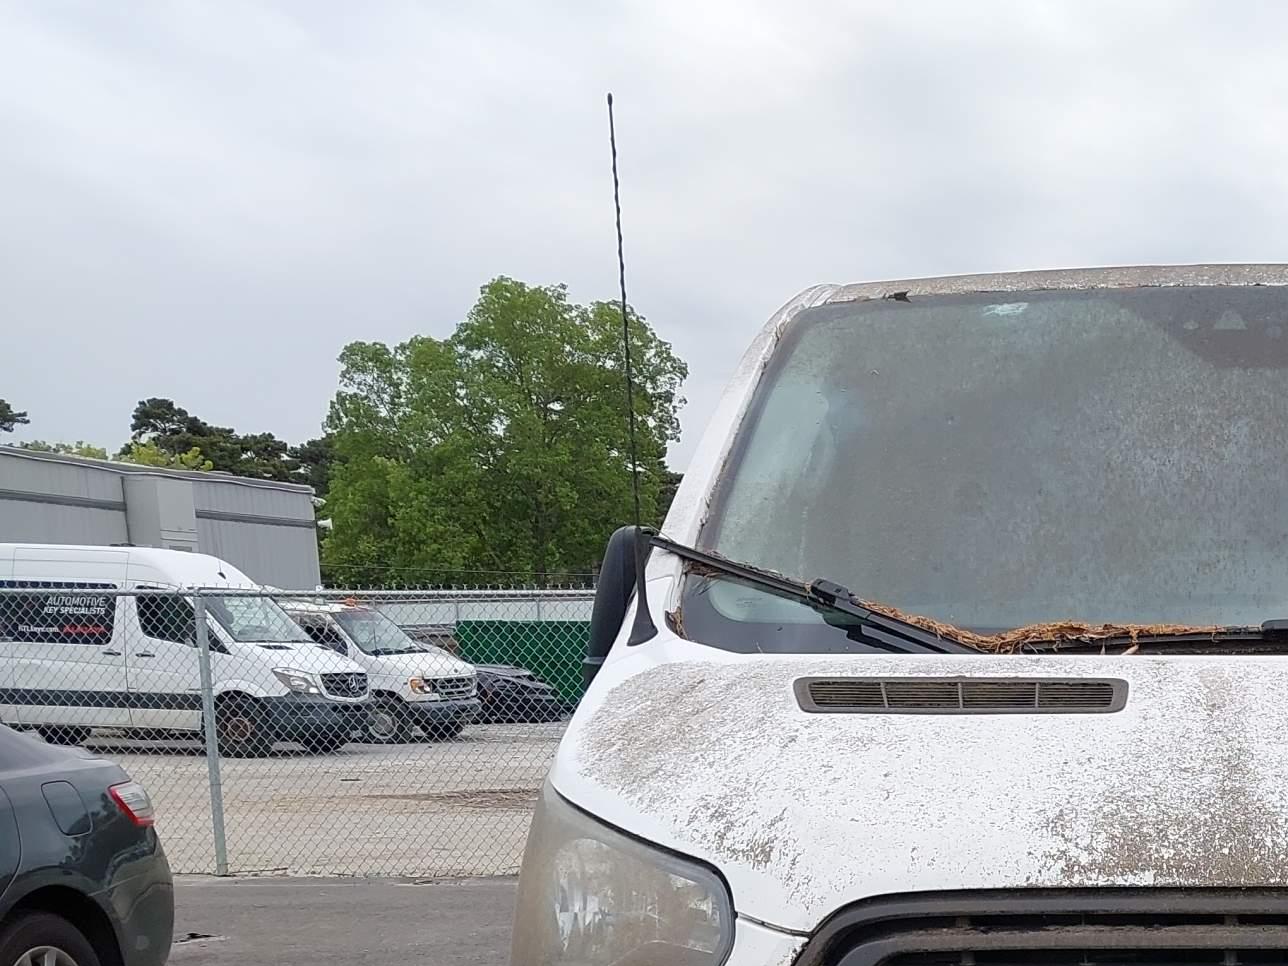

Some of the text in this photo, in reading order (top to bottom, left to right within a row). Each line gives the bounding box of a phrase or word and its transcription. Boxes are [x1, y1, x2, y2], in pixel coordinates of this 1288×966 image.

[46, 596, 106, 607] AUTOMOTIVE
[43, 606, 106, 615] KEY SPECIALISTS
